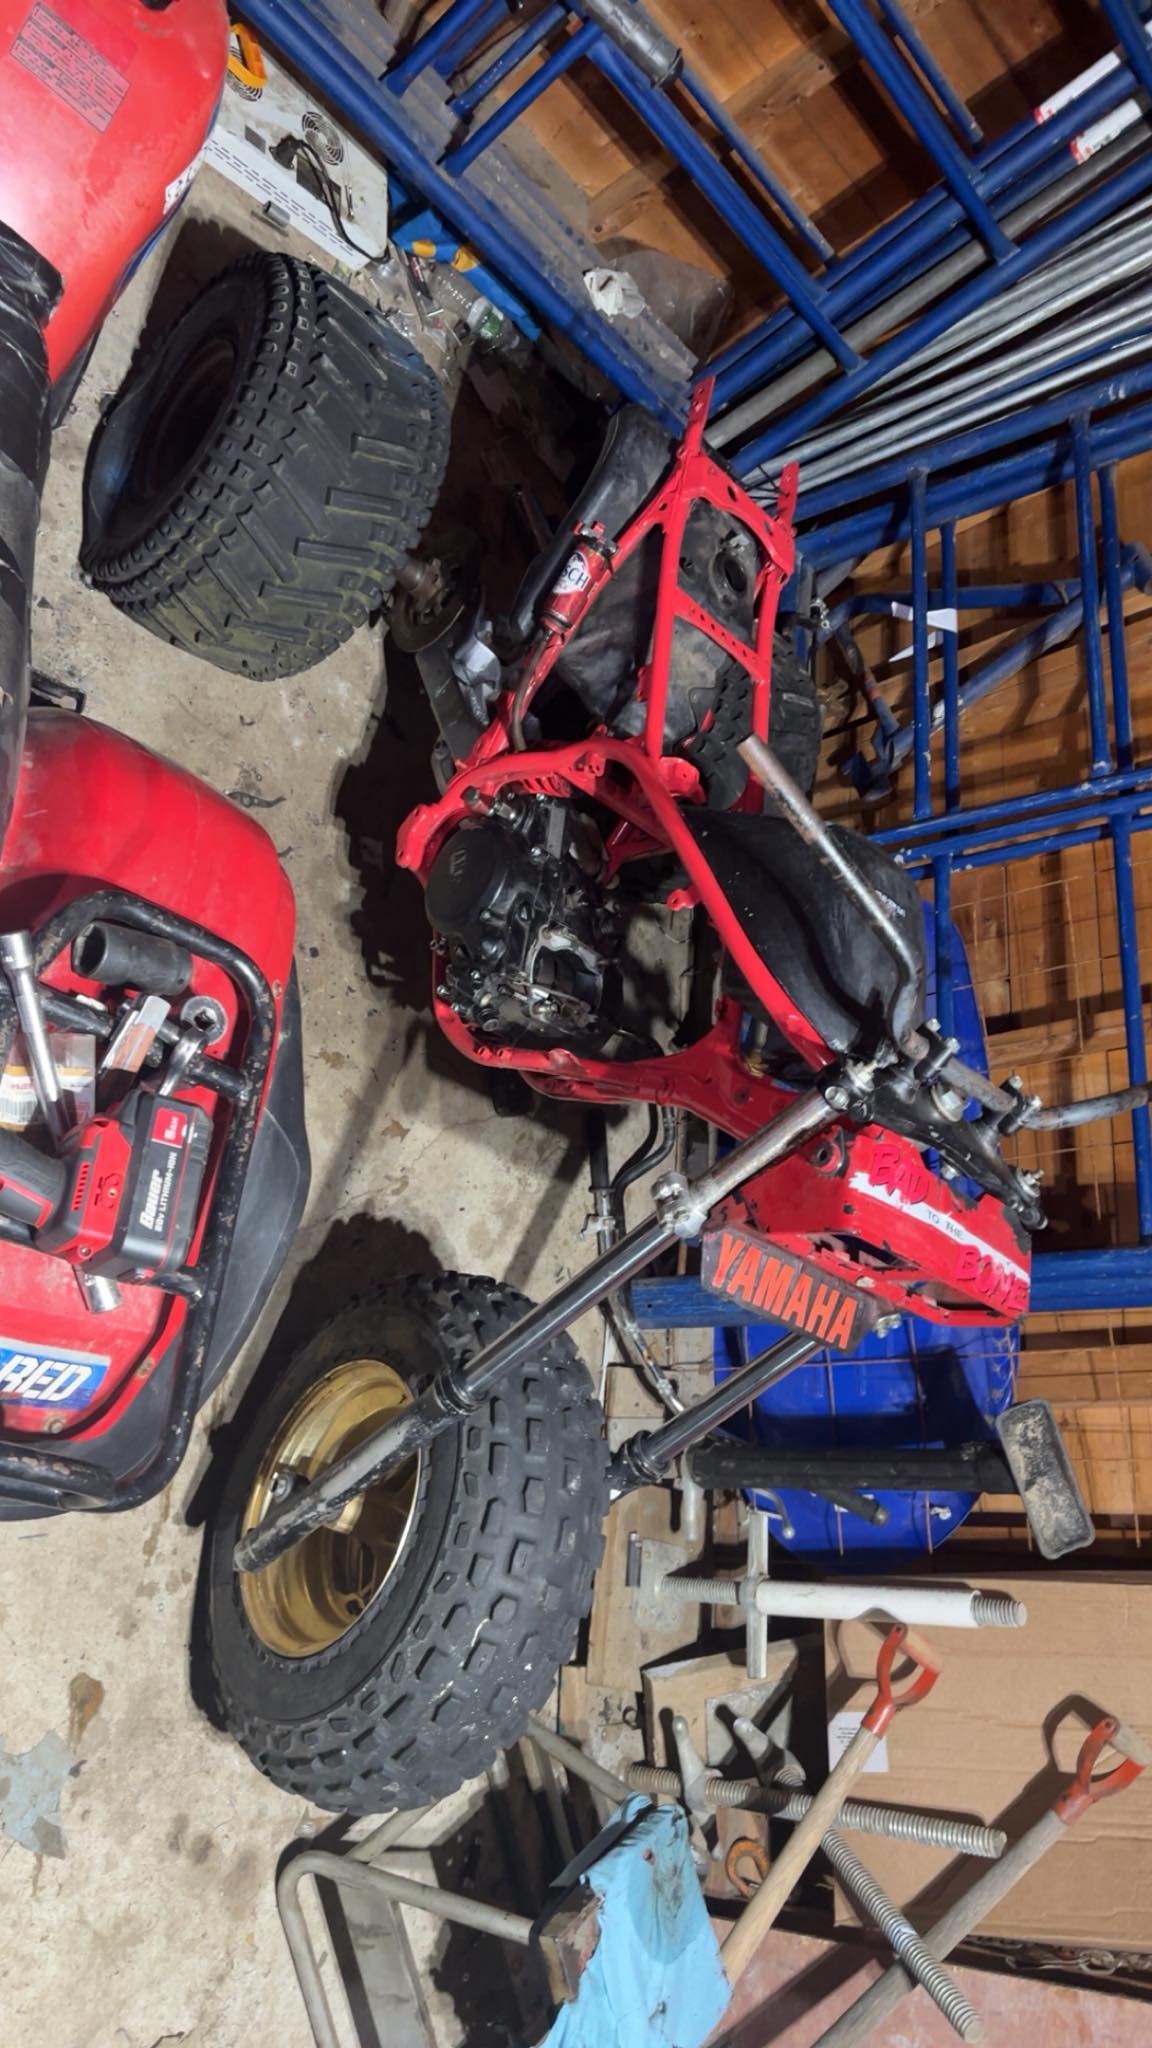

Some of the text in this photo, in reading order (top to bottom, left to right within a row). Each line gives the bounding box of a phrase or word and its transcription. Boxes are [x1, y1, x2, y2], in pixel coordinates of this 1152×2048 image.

[140, 1168, 163, 1231] Bauer
[161, 1152, 178, 1211] LITHIUM-ION
[869, 1143, 929, 1205] BAD
[926, 1210, 965, 1241] TO THE
[711, 1231, 858, 1350] YAMAHA
[957, 1245, 1029, 1312] BONE
[0, 1354, 92, 1402] RED
